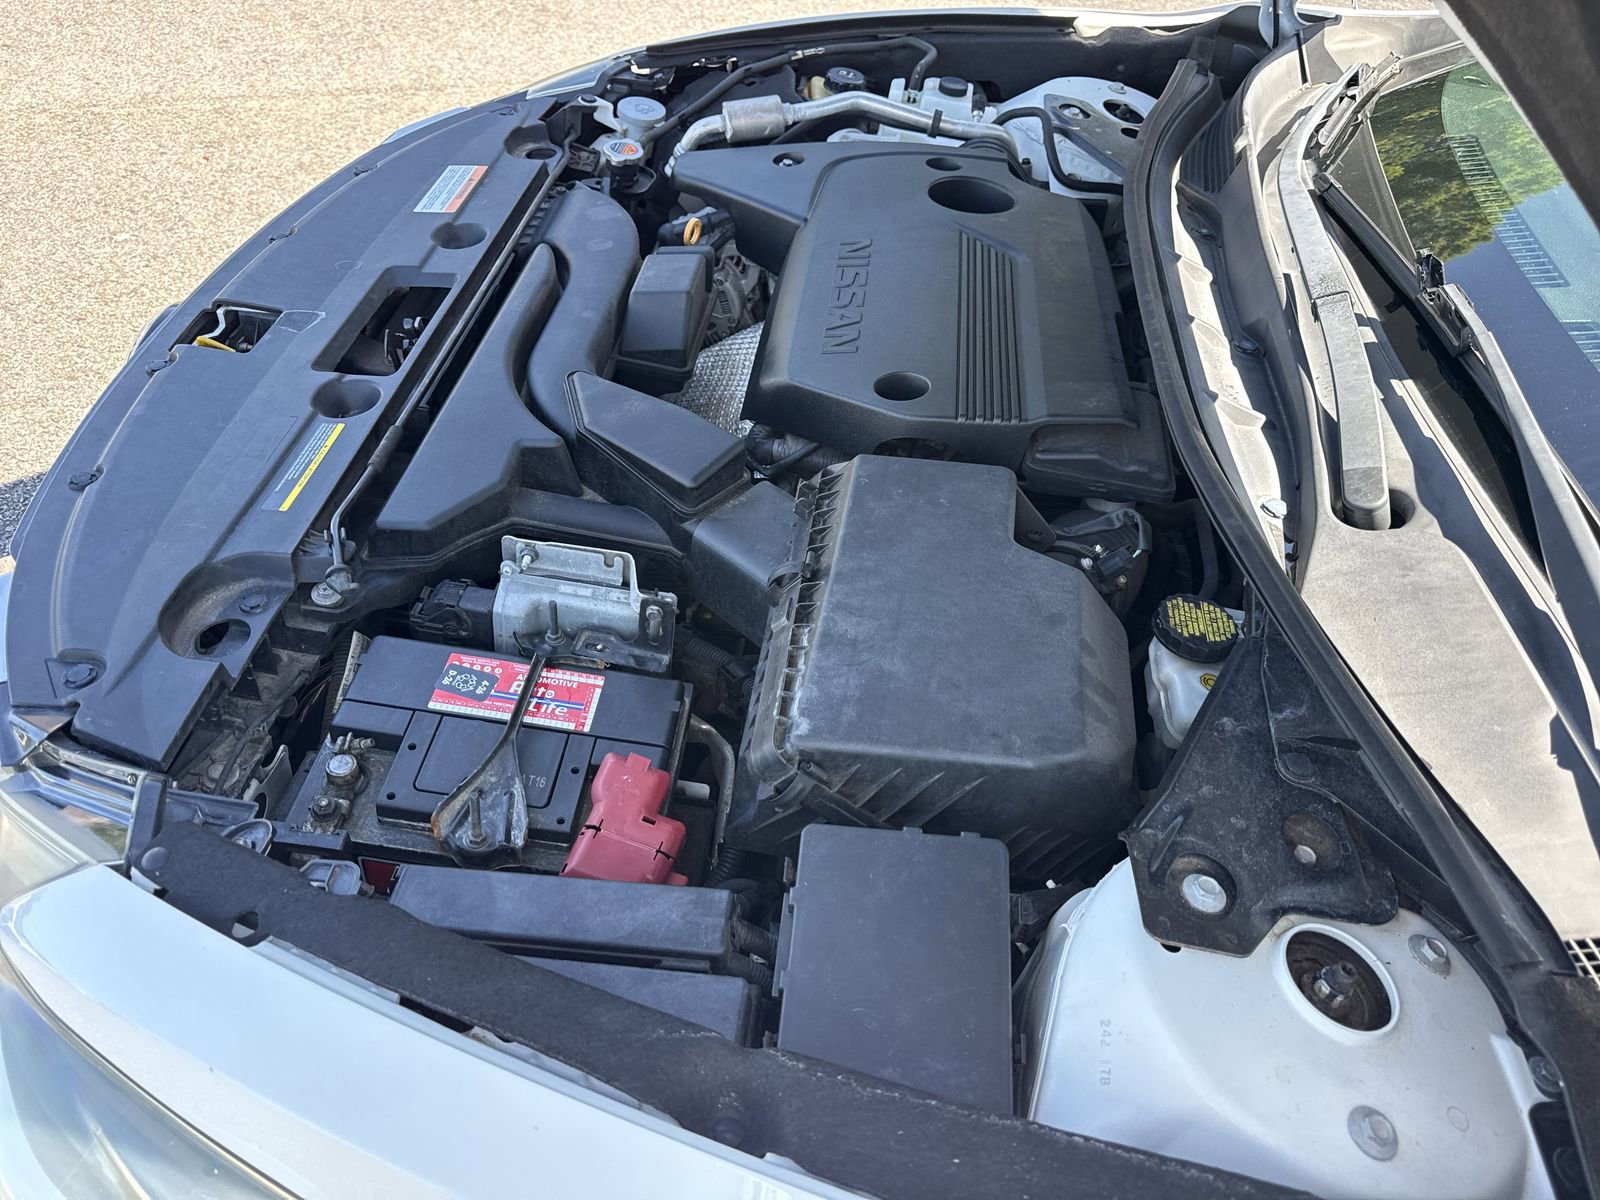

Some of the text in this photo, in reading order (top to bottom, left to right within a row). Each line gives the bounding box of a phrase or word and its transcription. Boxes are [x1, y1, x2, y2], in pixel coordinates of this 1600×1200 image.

[820, 238, 873, 355] NISSAN
[508, 680, 555, 699] Ato
[516, 674, 579, 689] AMOTIVE
[527, 697, 569, 716] Life
[1099, 1018, 1112, 1048] 242
